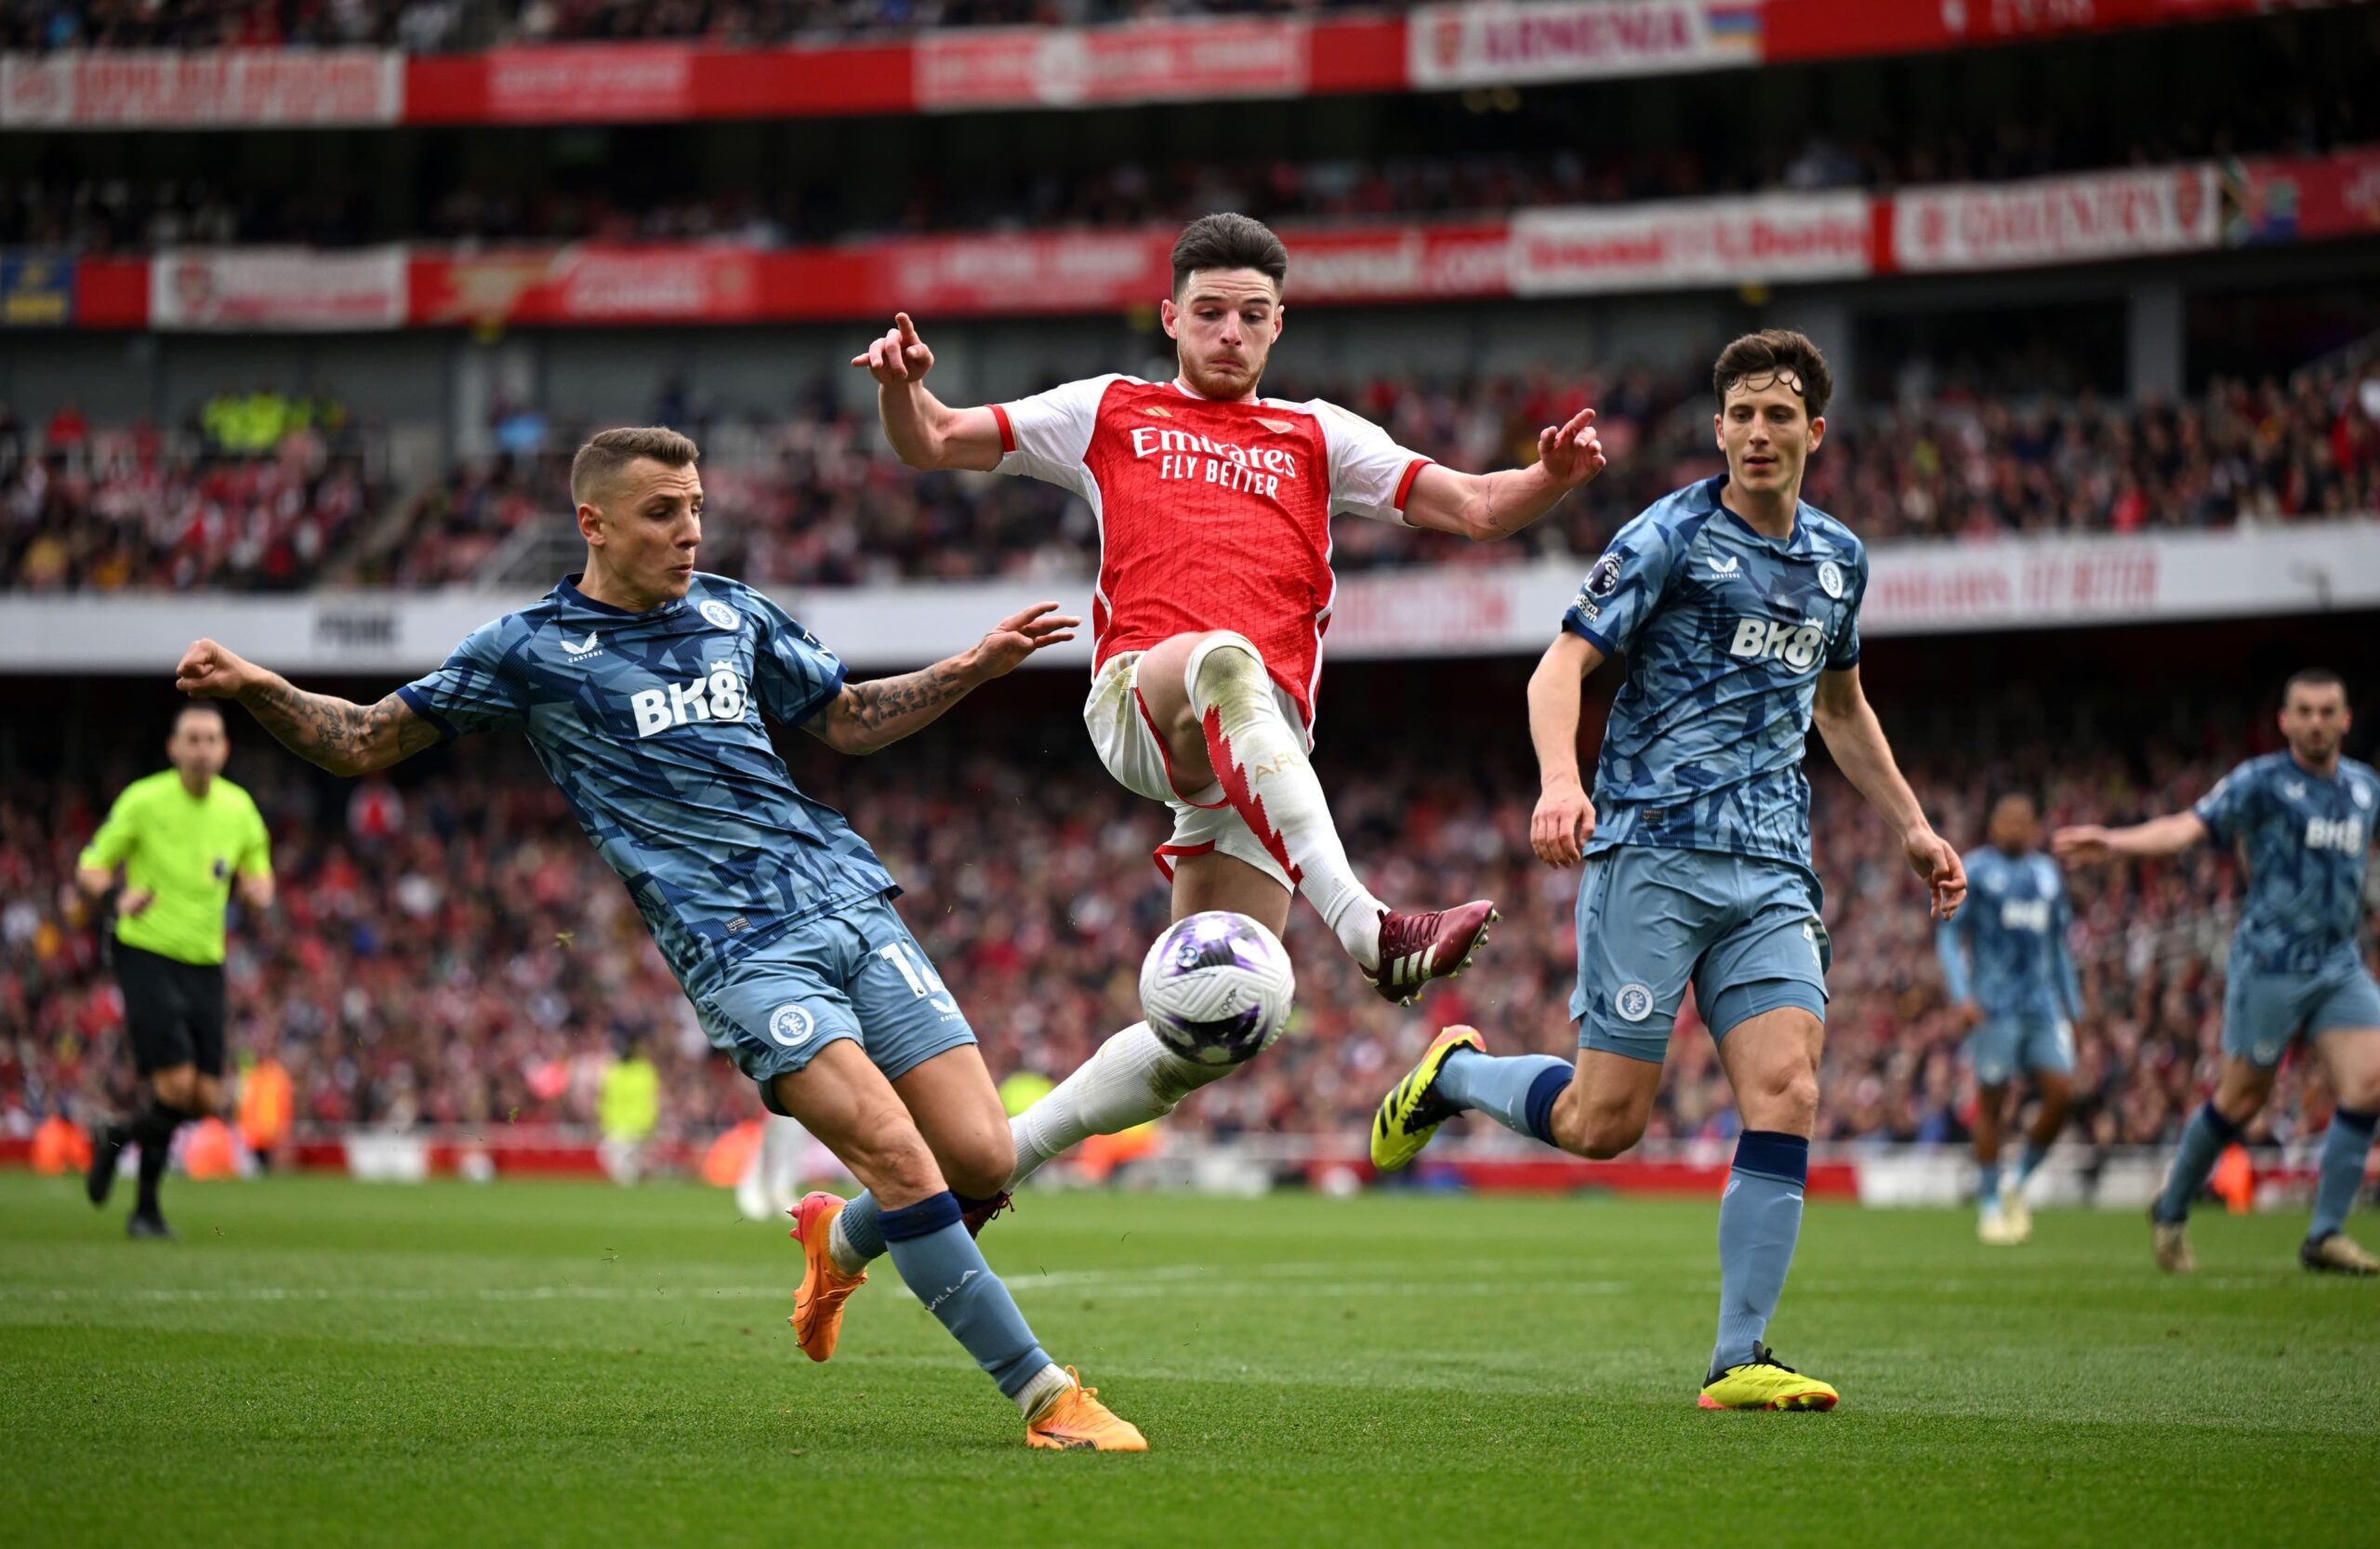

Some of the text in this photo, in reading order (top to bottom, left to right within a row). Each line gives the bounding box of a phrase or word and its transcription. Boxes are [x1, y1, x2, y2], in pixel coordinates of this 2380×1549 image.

[1130, 427, 1296, 479] Emirates
[1161, 455, 1279, 499] FLY BETTER
[568, 650, 603, 663] CASTORE
[1730, 617, 1822, 669] BK8
[630, 667, 743, 738] BK8
[925, 1270, 979, 1310] VILLA
